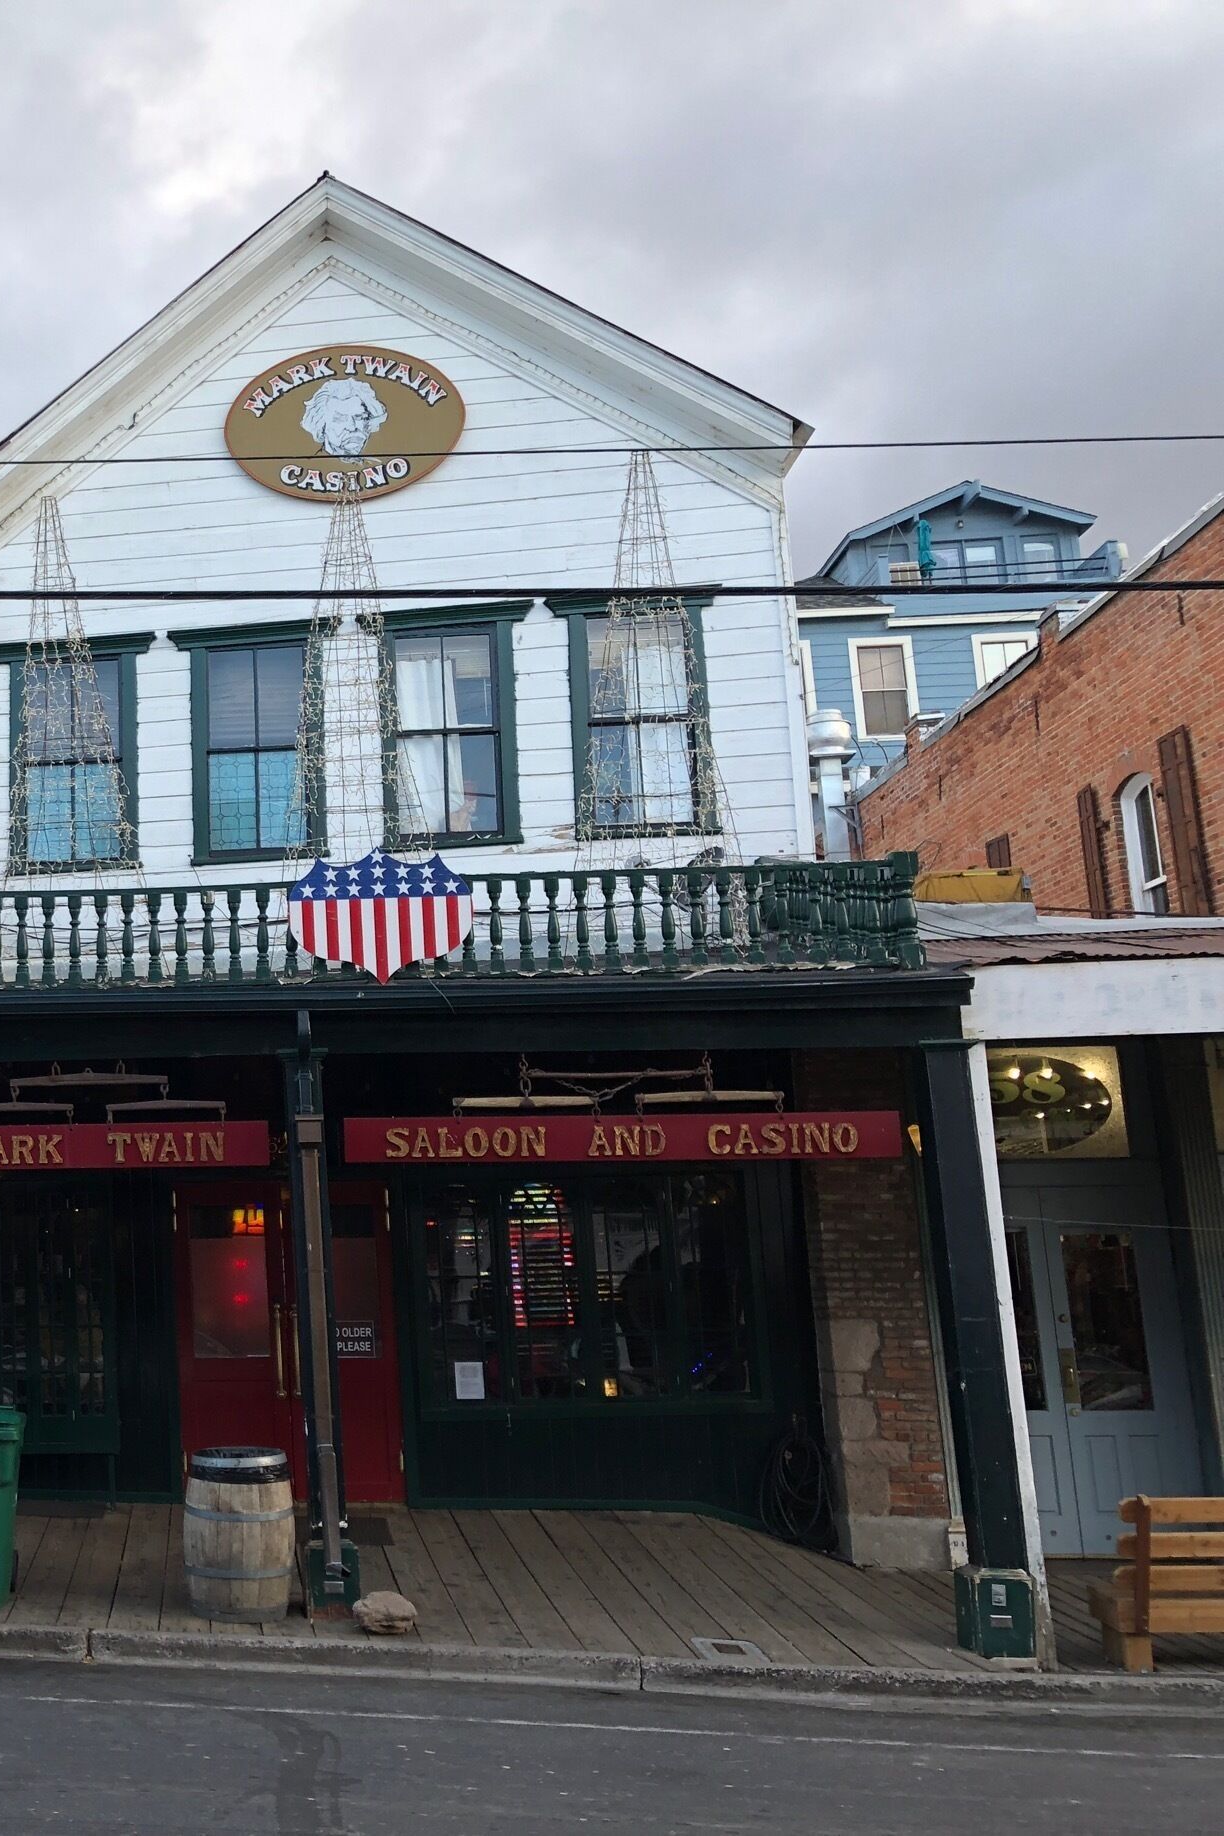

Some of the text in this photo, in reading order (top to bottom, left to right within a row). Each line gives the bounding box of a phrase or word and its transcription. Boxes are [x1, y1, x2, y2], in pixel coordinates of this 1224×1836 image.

[243, 355, 448, 418] MARK TWAIN
[280, 458, 410, 491] CASINO
[107, 1131, 225, 1164] TWAIN
[385, 1122, 859, 1158] SALOON AND CASINO
[337, 1341, 371, 1352] PLEASE
[342, 1327, 372, 1338] OLDER
